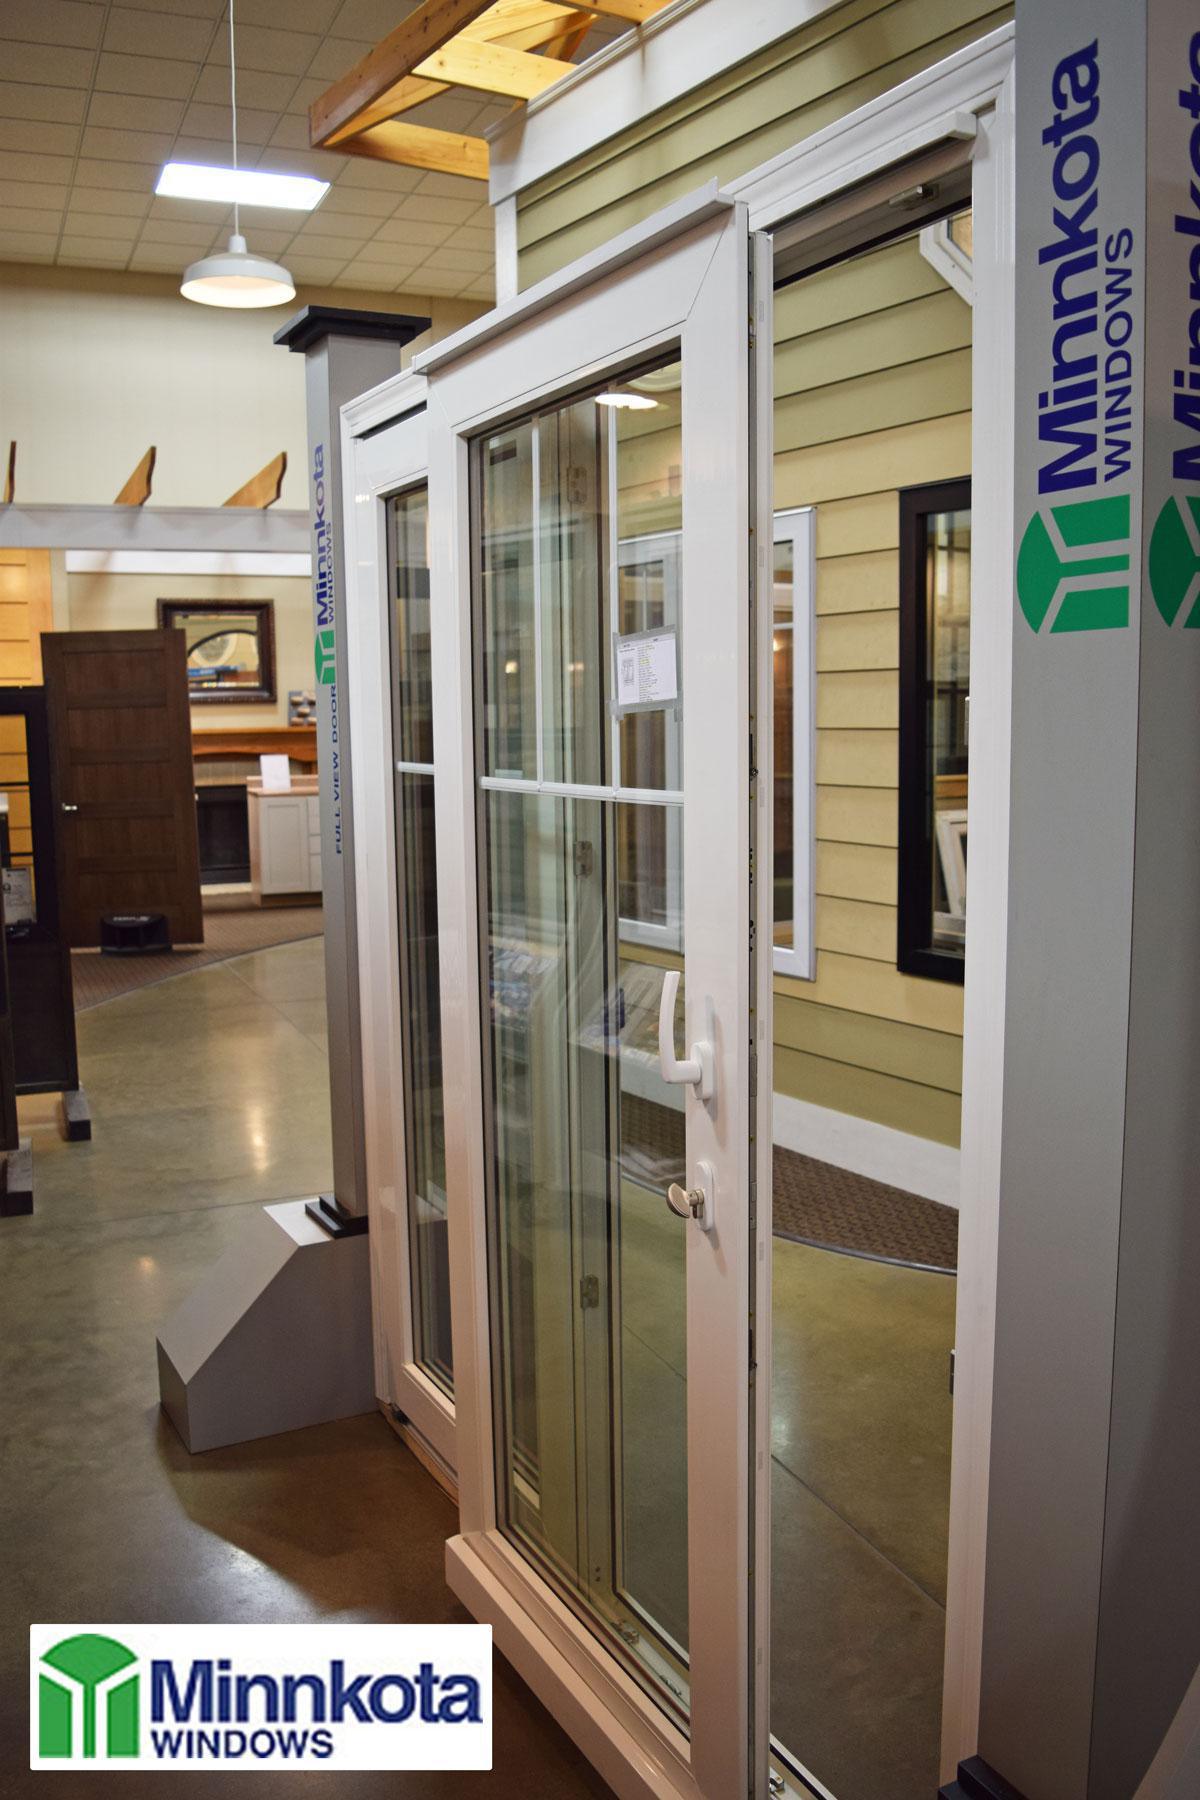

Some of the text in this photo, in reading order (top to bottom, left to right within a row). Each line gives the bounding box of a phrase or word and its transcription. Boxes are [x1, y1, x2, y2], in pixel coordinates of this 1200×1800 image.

[1038, 37, 1100, 495] Minnkota
[1104, 228, 1134, 483] WINDOWS
[313, 443, 328, 627] Minnkota
[326, 522, 334, 624] WINDOWS
[330, 685, 338, 743] DOOR
[332, 751, 340, 801] VIEW
